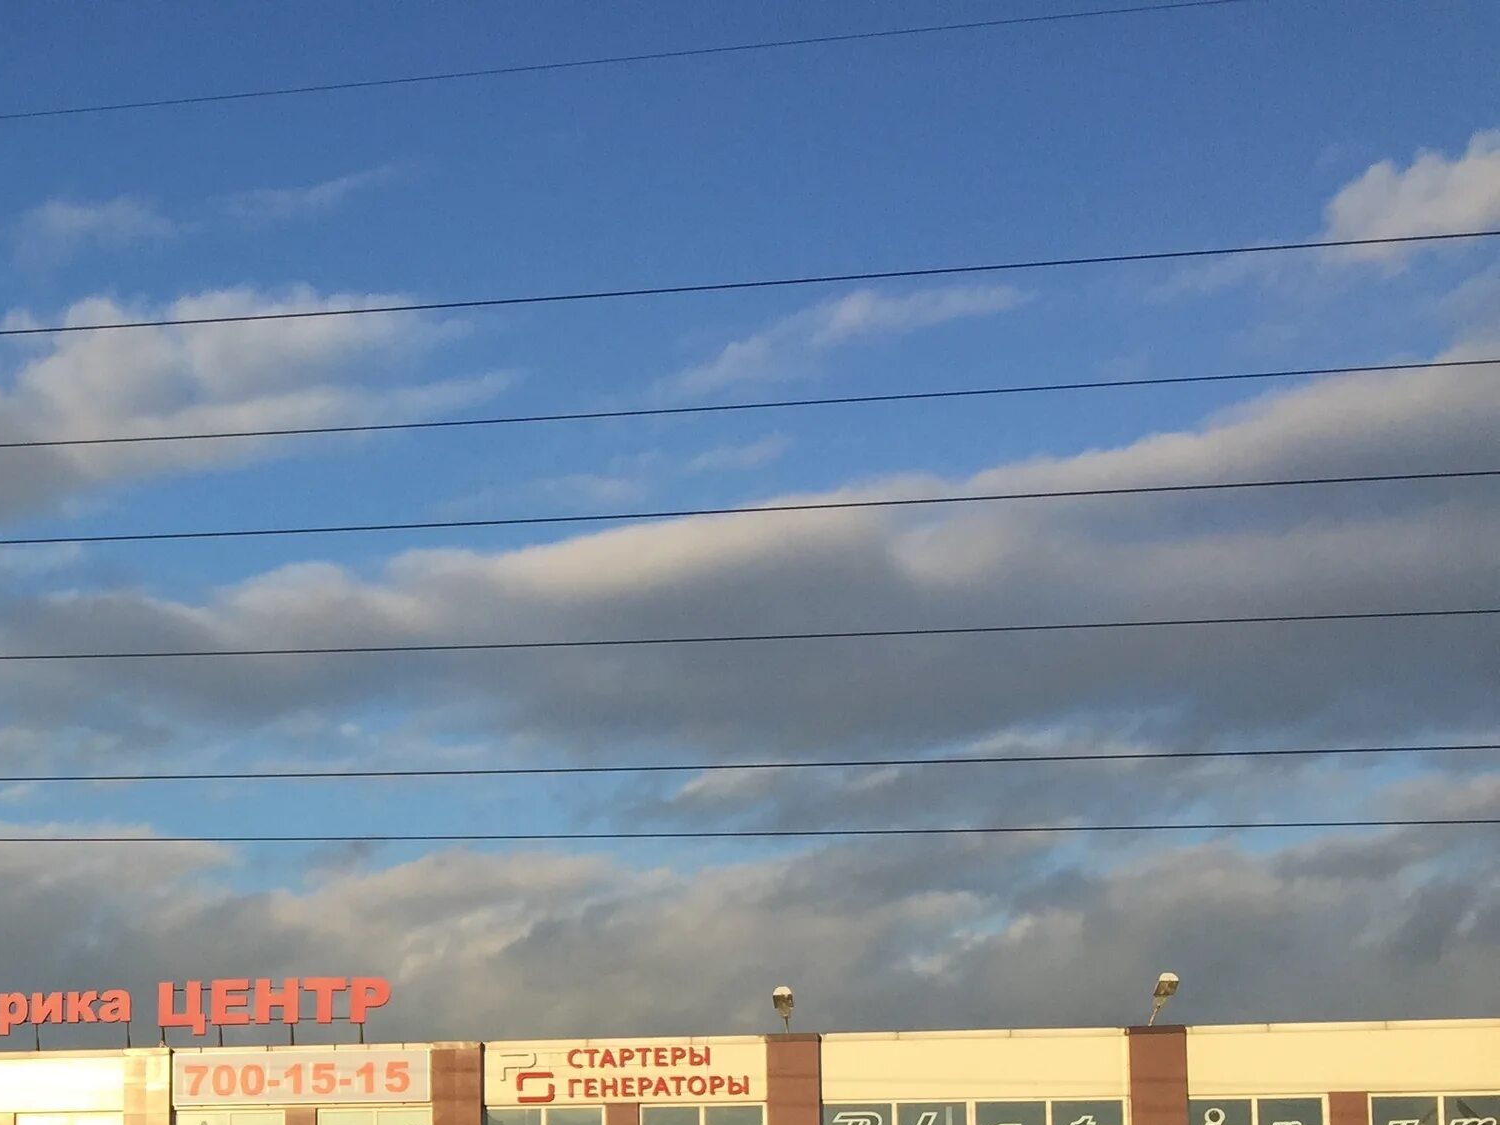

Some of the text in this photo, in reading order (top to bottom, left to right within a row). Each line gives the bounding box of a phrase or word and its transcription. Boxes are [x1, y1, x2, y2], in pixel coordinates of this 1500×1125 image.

[158, 976, 392, 1036] ЦЕНТР
[567, 1046, 712, 1069] СТАРТЕРЫ
[184, 1061, 411, 1097] 700-15-15
[567, 1075, 750, 1098] ГЕНЕРАТОРЫ
